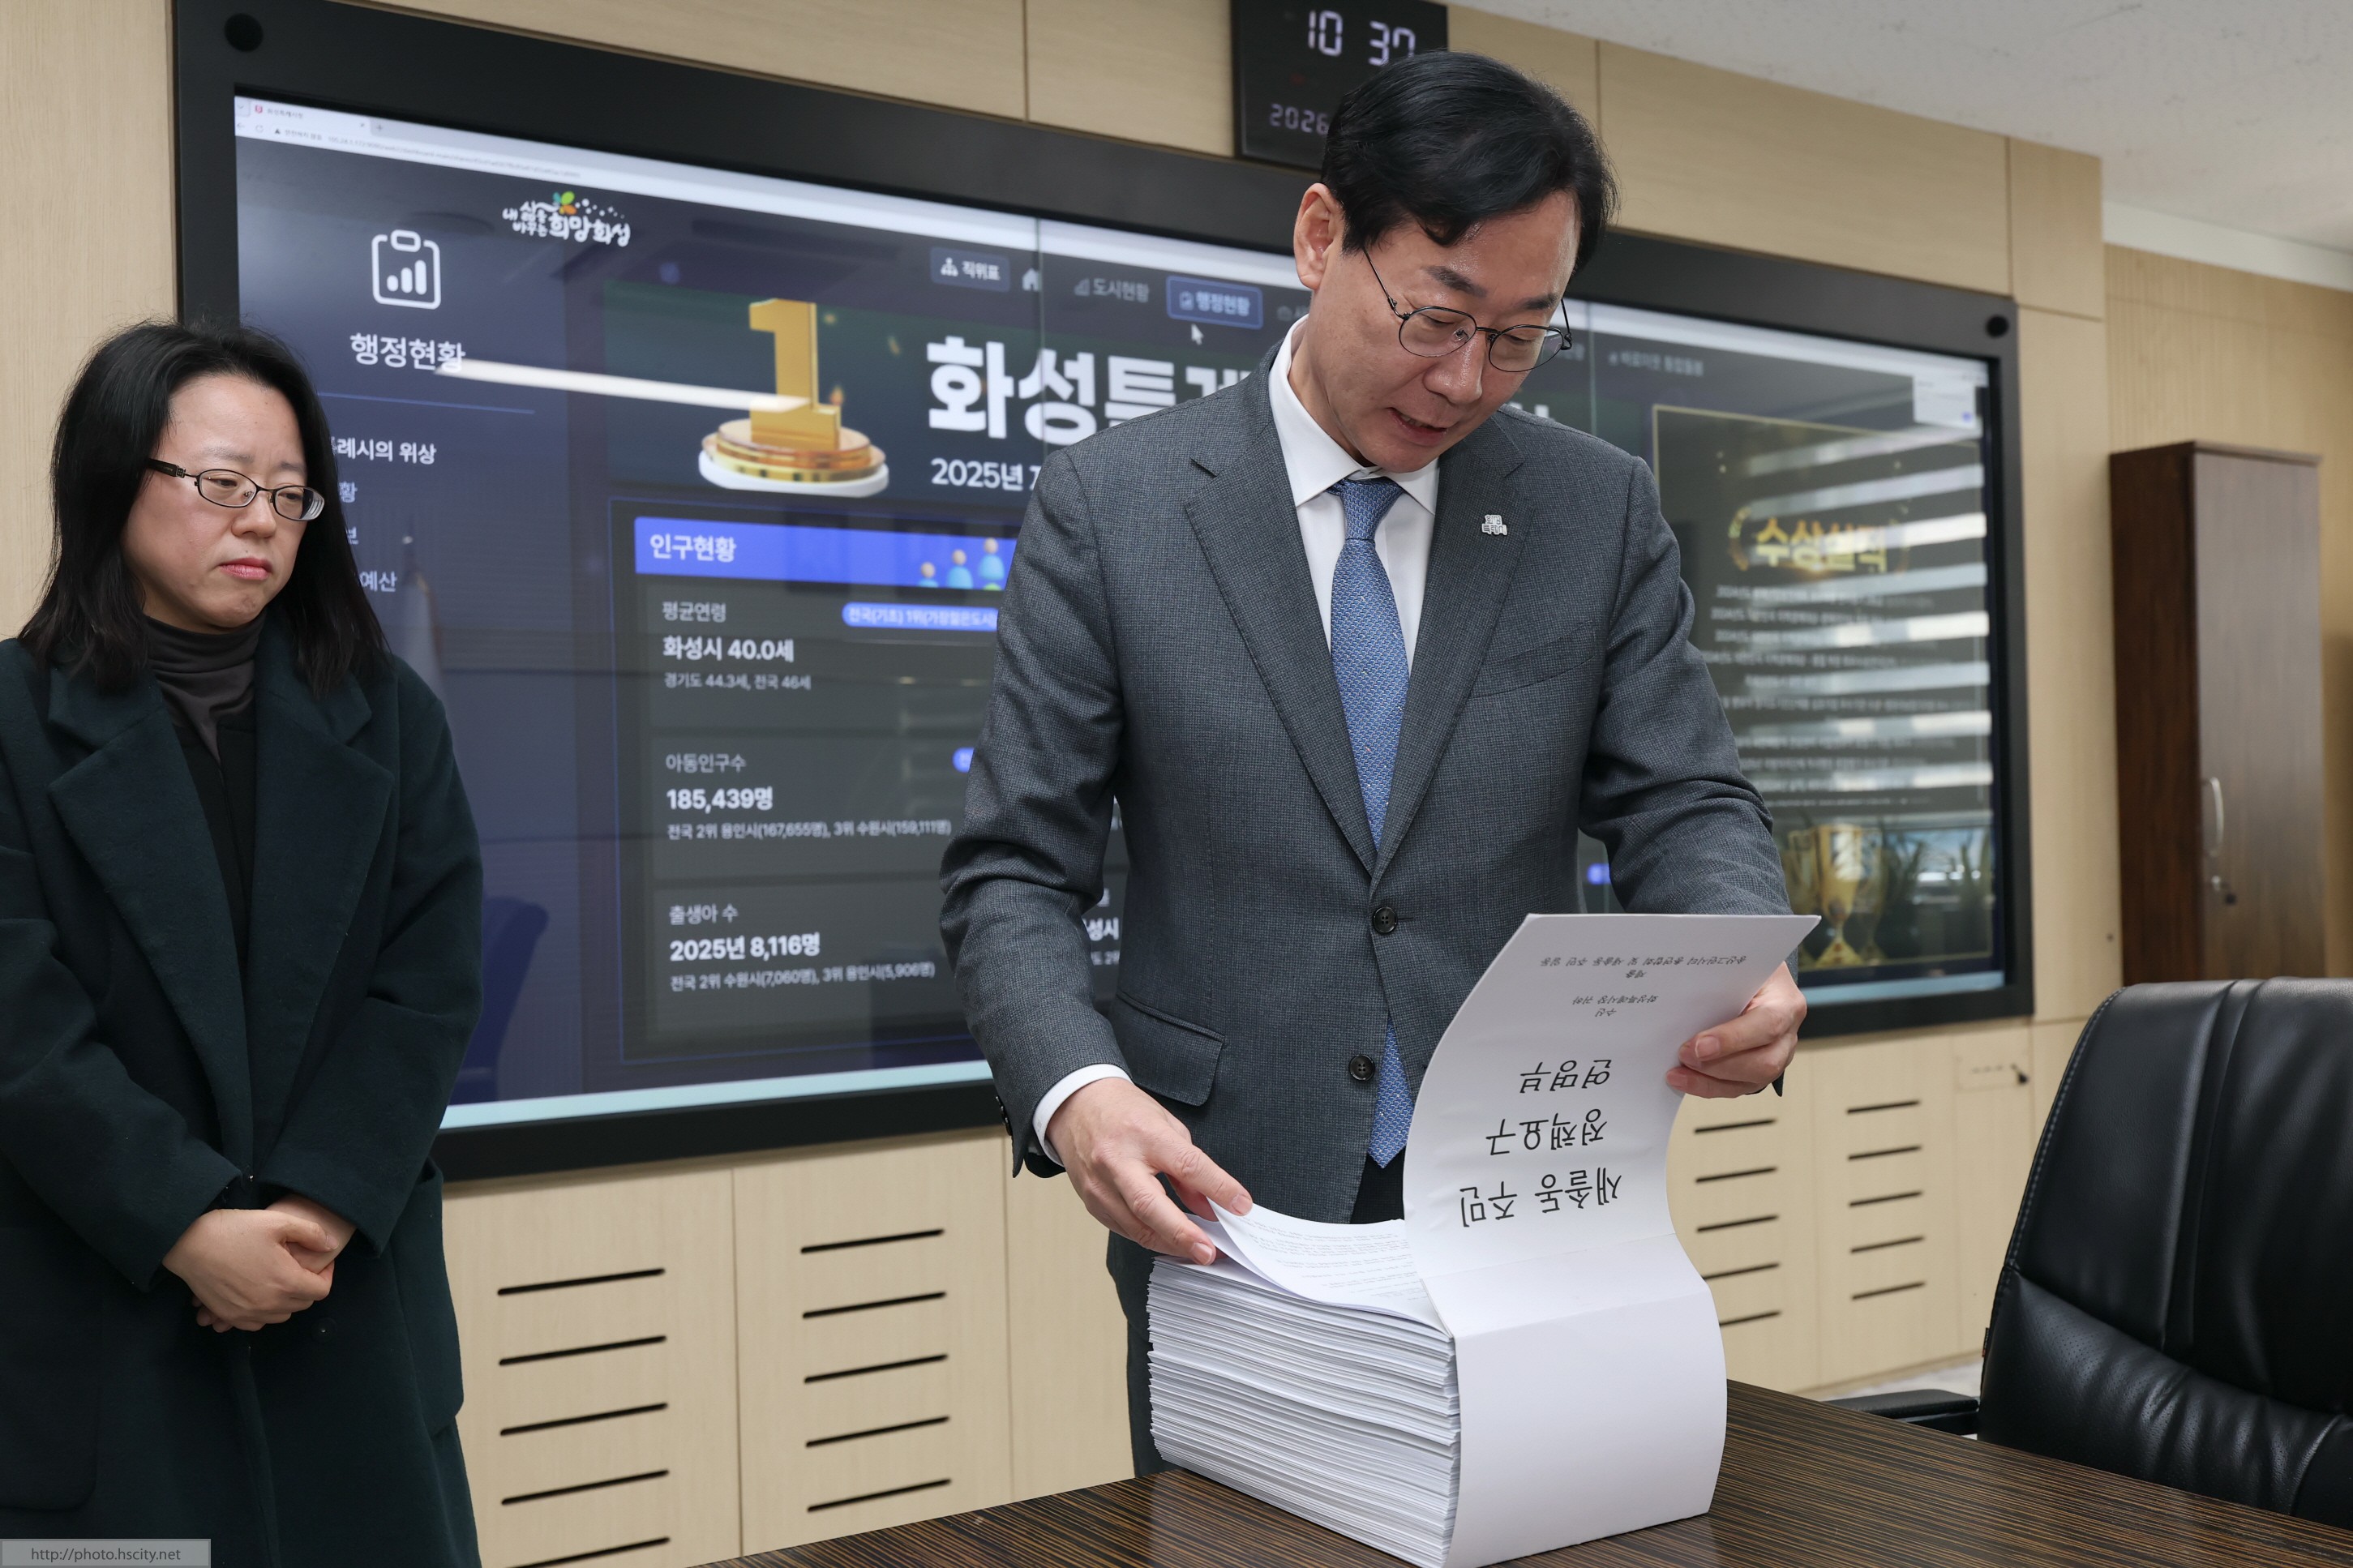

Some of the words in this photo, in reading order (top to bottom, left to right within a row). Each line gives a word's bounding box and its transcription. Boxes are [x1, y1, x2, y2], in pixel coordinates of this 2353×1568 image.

[1307, 10, 1344, 57] 10
[1368, 20, 1417, 66] 37
[1269, 103, 1330, 136] 2026
[1093, 277, 1150, 303] 도시현황
[1195, 290, 1251, 318] 행정현황
[349, 332, 466, 375] 행정현황
[331, 436, 394, 463] 례시의
[398, 442, 437, 465] 위상
[931, 457, 1024, 492] 2025년
[649, 533, 737, 563] 인구현황
[662, 600, 727, 623] 평균연령
[662, 636, 723, 662] 화성시
[726, 638, 795, 663] 40.0세
[663, 672, 703, 689] 경기도
[754, 674, 778, 690] 전국
[665, 752, 748, 773] 아동인구수
[666, 786, 774, 814] 185,439명
[667, 824, 693, 840] 전국
[696, 823, 718, 839] 2위
[834, 821, 854, 837] 3위
[669, 903, 718, 926] 출생아
[721, 903, 739, 923] 수
[669, 934, 746, 962] 2025년
[749, 932, 821, 962] 8,116명
[670, 975, 696, 992] 전국
[699, 974, 721, 989] 2위
[821, 967, 843, 983] 3위
[1626, 969, 1647, 979] 제출
[1571, 996, 1594, 1005] 귀하
[1594, 1008, 1617, 1017] 수신
[1597, 994, 1659, 1005] 화성특례시장
[1519, 1059, 1612, 1094] 연명부
[1485, 1108, 1608, 1156] 정책요구
[1459, 1180, 1518, 1227] 주민
[1534, 1167, 1622, 1214] 새솔동
